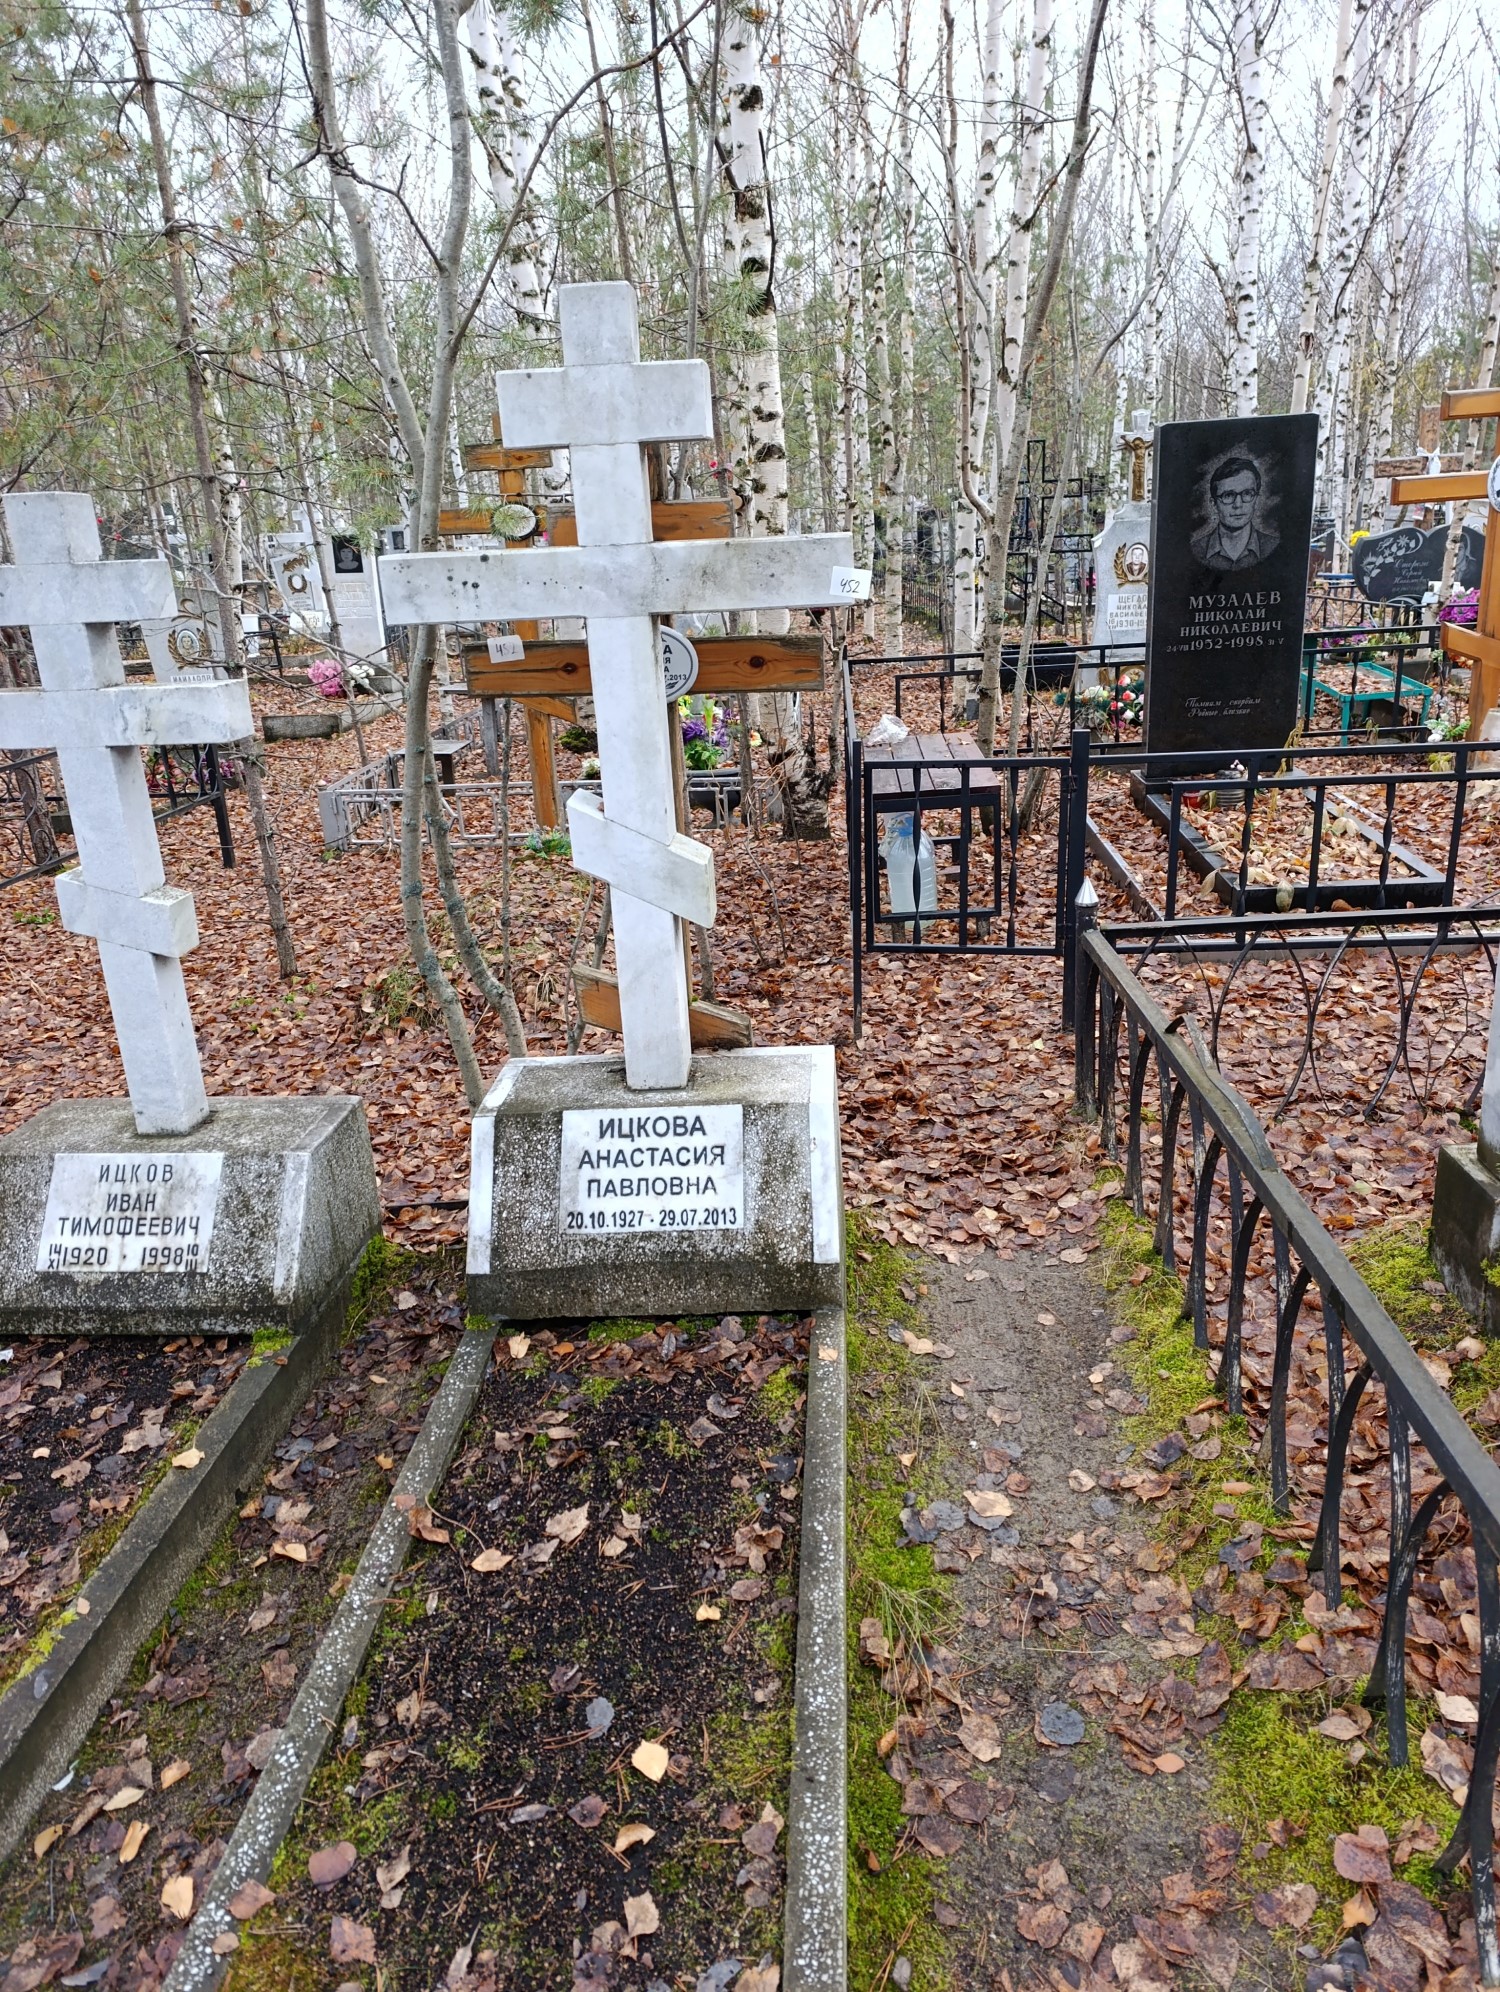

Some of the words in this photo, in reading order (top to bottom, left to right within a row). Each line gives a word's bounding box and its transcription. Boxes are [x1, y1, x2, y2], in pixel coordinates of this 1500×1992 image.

[840, 578, 860, 593] 452
[1189, 591, 1281, 609] МУЗАЛЕВ
[1194, 607, 1266, 622] НИКОЛАЙ
[1180, 620, 1281, 637] НИКОЛАЕВИЧ
[598, 1115, 708, 1142] ИЦКОВА
[578, 1145, 726, 1170] АНАСТАСИЯ
[99, 1163, 174, 1183] ИЦКОВ
[586, 1176, 718, 1199] ПАВЛОВНА
[105, 1193, 157, 1213] ИВАН
[58, 1215, 201, 1237] ТИМОФЕЕВИЧ
[566, 1210, 645, 1230] 20.10.1927
[658, 1206, 738, 1227] 29.07.2013
[62, 1246, 109, 1267] 1920
[141, 1246, 184, 1266] 1998
